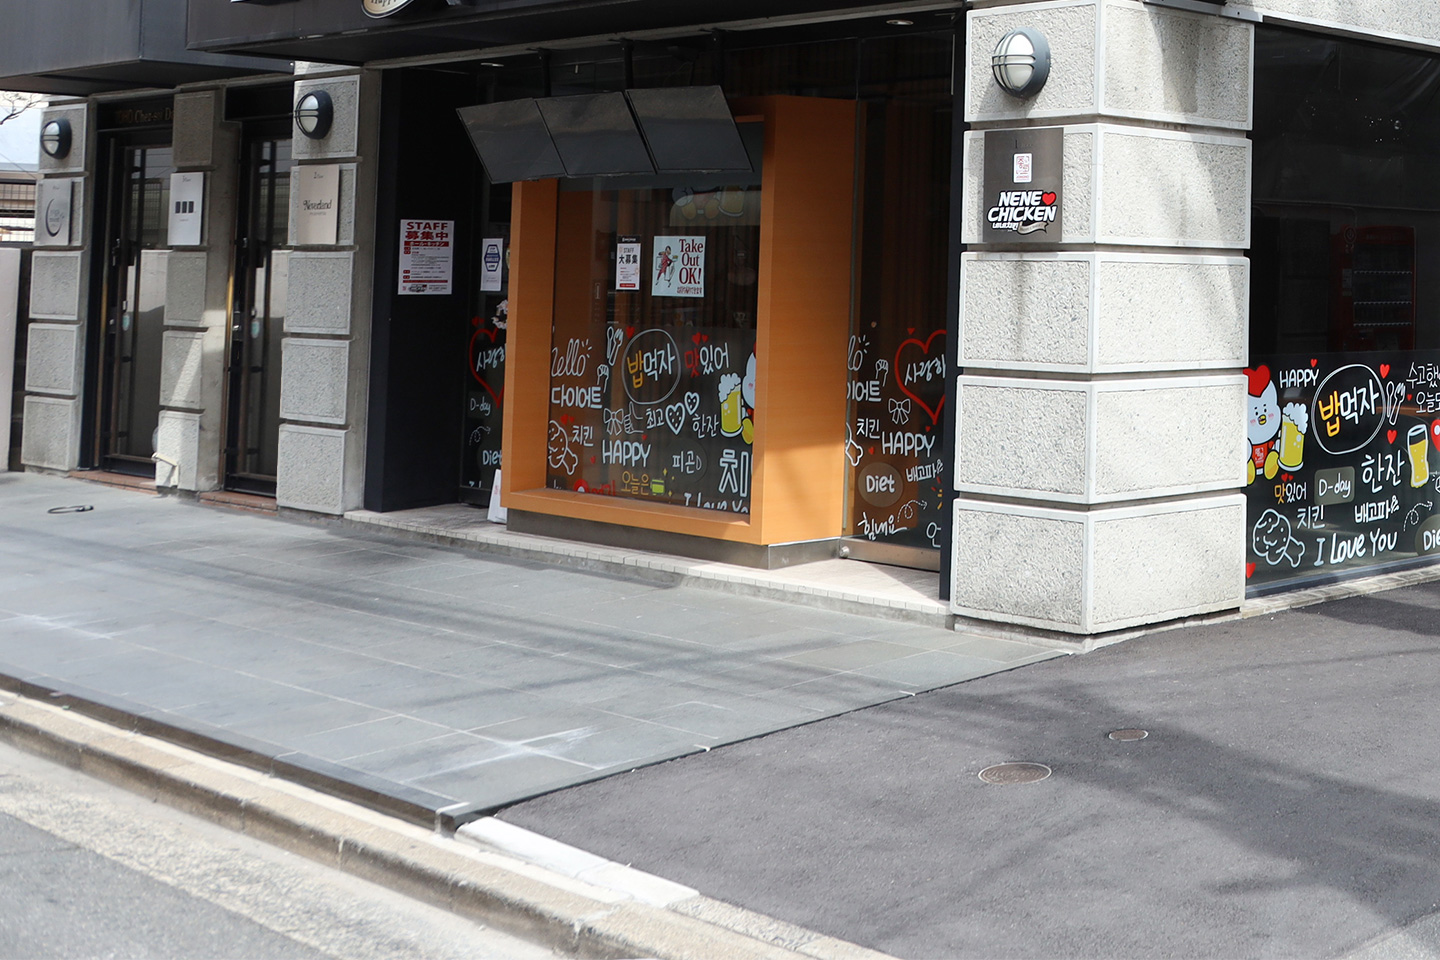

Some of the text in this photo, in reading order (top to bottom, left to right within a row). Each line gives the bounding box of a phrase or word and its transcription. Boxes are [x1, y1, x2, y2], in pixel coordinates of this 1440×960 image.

[999, 191, 1043, 207] NENE
[987, 206, 1057, 222] CHICKEN
[405, 231, 448, 240] 募集中
[406, 221, 448, 230] STAFF
[679, 238, 703, 253] Take
[618, 254, 638, 265] 大募集
[681, 252, 700, 267] Out
[678, 267, 702, 285] OK!
[626, 342, 676, 389] 밥먹자
[684, 341, 730, 379] 맛있어
[1279, 368, 1320, 389] HAPPY
[469, 395, 492, 417] D-day
[551, 383, 603, 409] 다이어트
[645, 407, 665, 429] 최고
[1318, 378, 1380, 438] 밥먹자
[571, 424, 594, 447] 치킨
[692, 413, 720, 439] 한잔
[856, 417, 881, 439] 치킨
[602, 439, 652, 468] HAPPY
[881, 430, 936, 458] HAPPY
[1361, 449, 1406, 494] 한잔
[865, 474, 896, 494] Diet
[1274, 481, 1307, 505] 맛있어
[1319, 472, 1351, 499] D-day
[1296, 504, 1326, 530] 치킨
[1313, 537, 1326, 567] I
[1369, 527, 1398, 557] You
